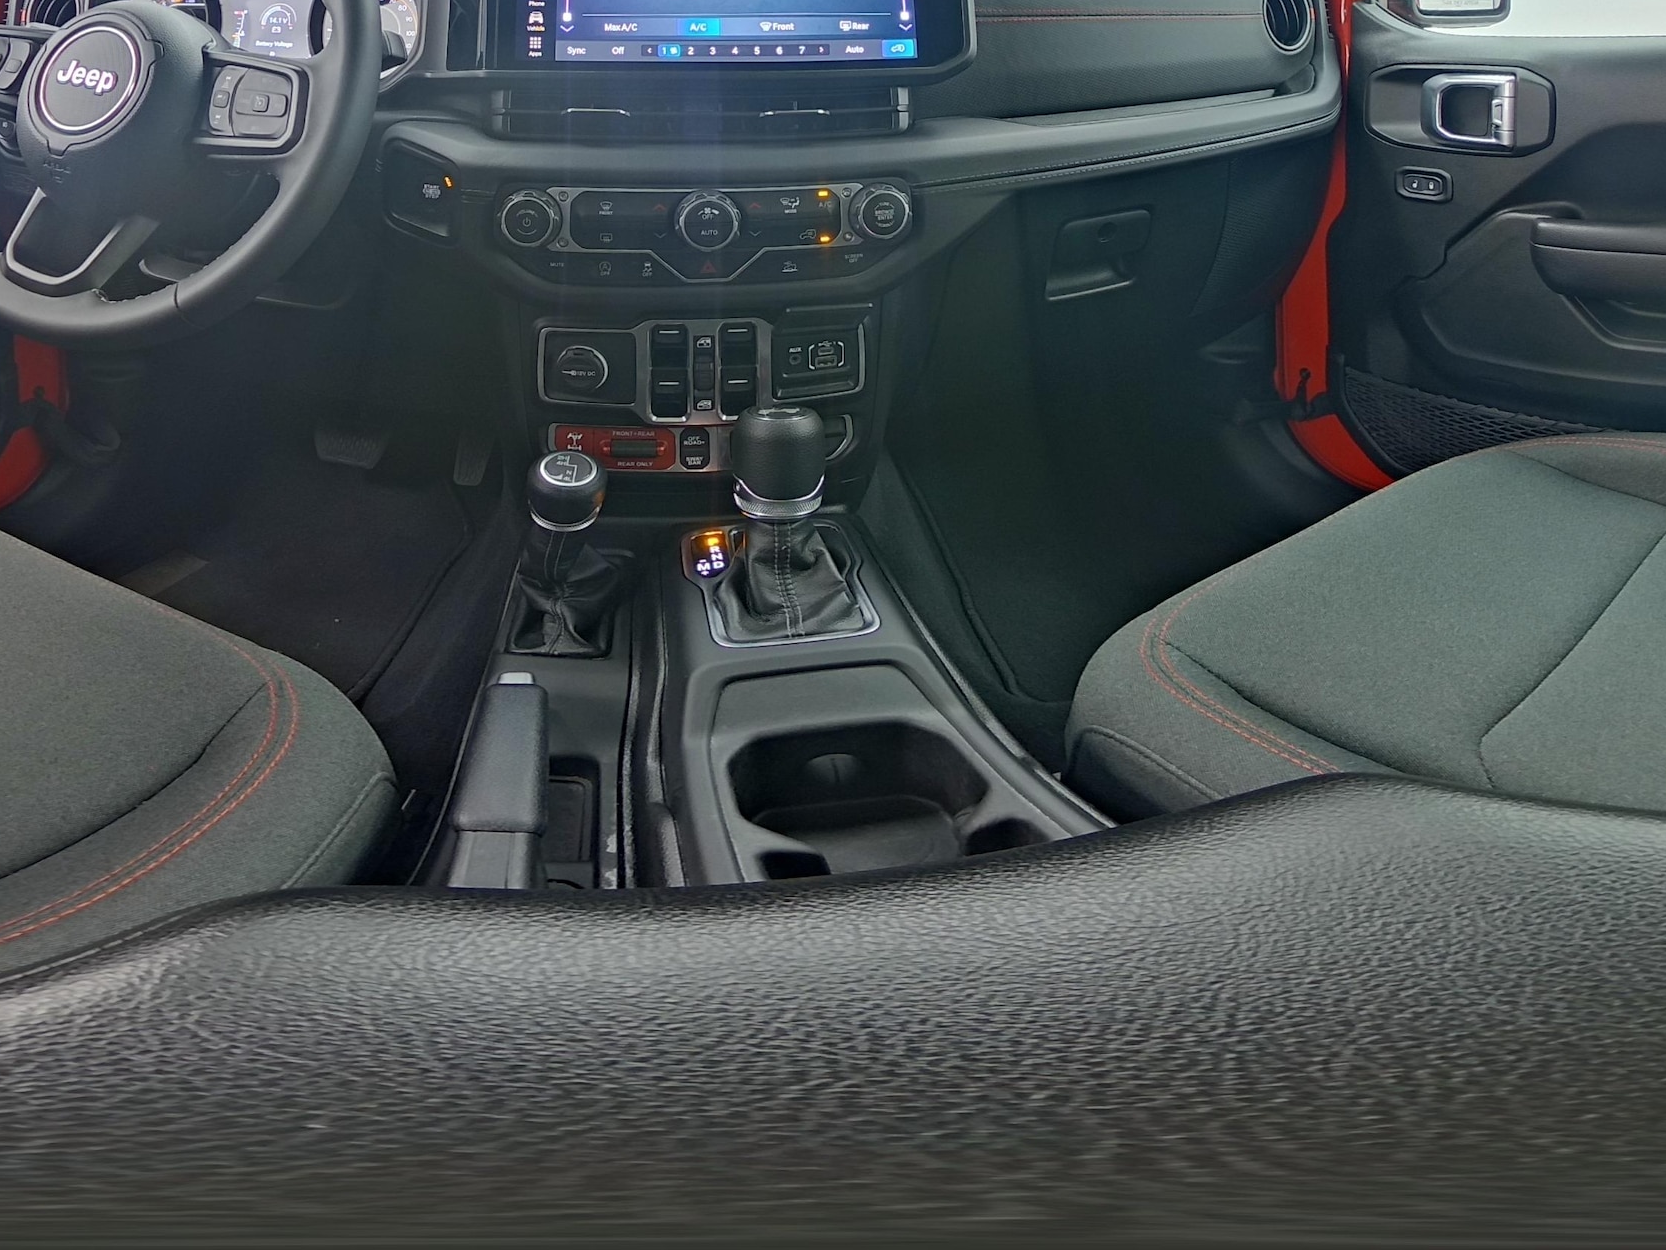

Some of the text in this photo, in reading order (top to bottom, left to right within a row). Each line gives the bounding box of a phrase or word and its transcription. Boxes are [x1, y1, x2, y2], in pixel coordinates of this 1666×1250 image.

[622, 23, 638, 32] A/C
[690, 23, 707, 31] A/C
[773, 22, 794, 31] Front
[852, 22, 870, 30] Rear
[567, 46, 586, 55] Sync
[612, 46, 625, 55] Off
[661, 47, 667, 55] 1
[687, 47, 695, 55] 2
[709, 47, 717, 55] 3
[732, 47, 738, 55] 4
[754, 47, 760, 55] 5
[776, 47, 783, 55] 6
[799, 47, 806, 55] 7
[845, 46, 864, 54] Auto
[57, 59, 118, 96] Jeep
[711, 553, 723, 561] N
[697, 562, 711, 571] M
[713, 561, 725, 569] D
